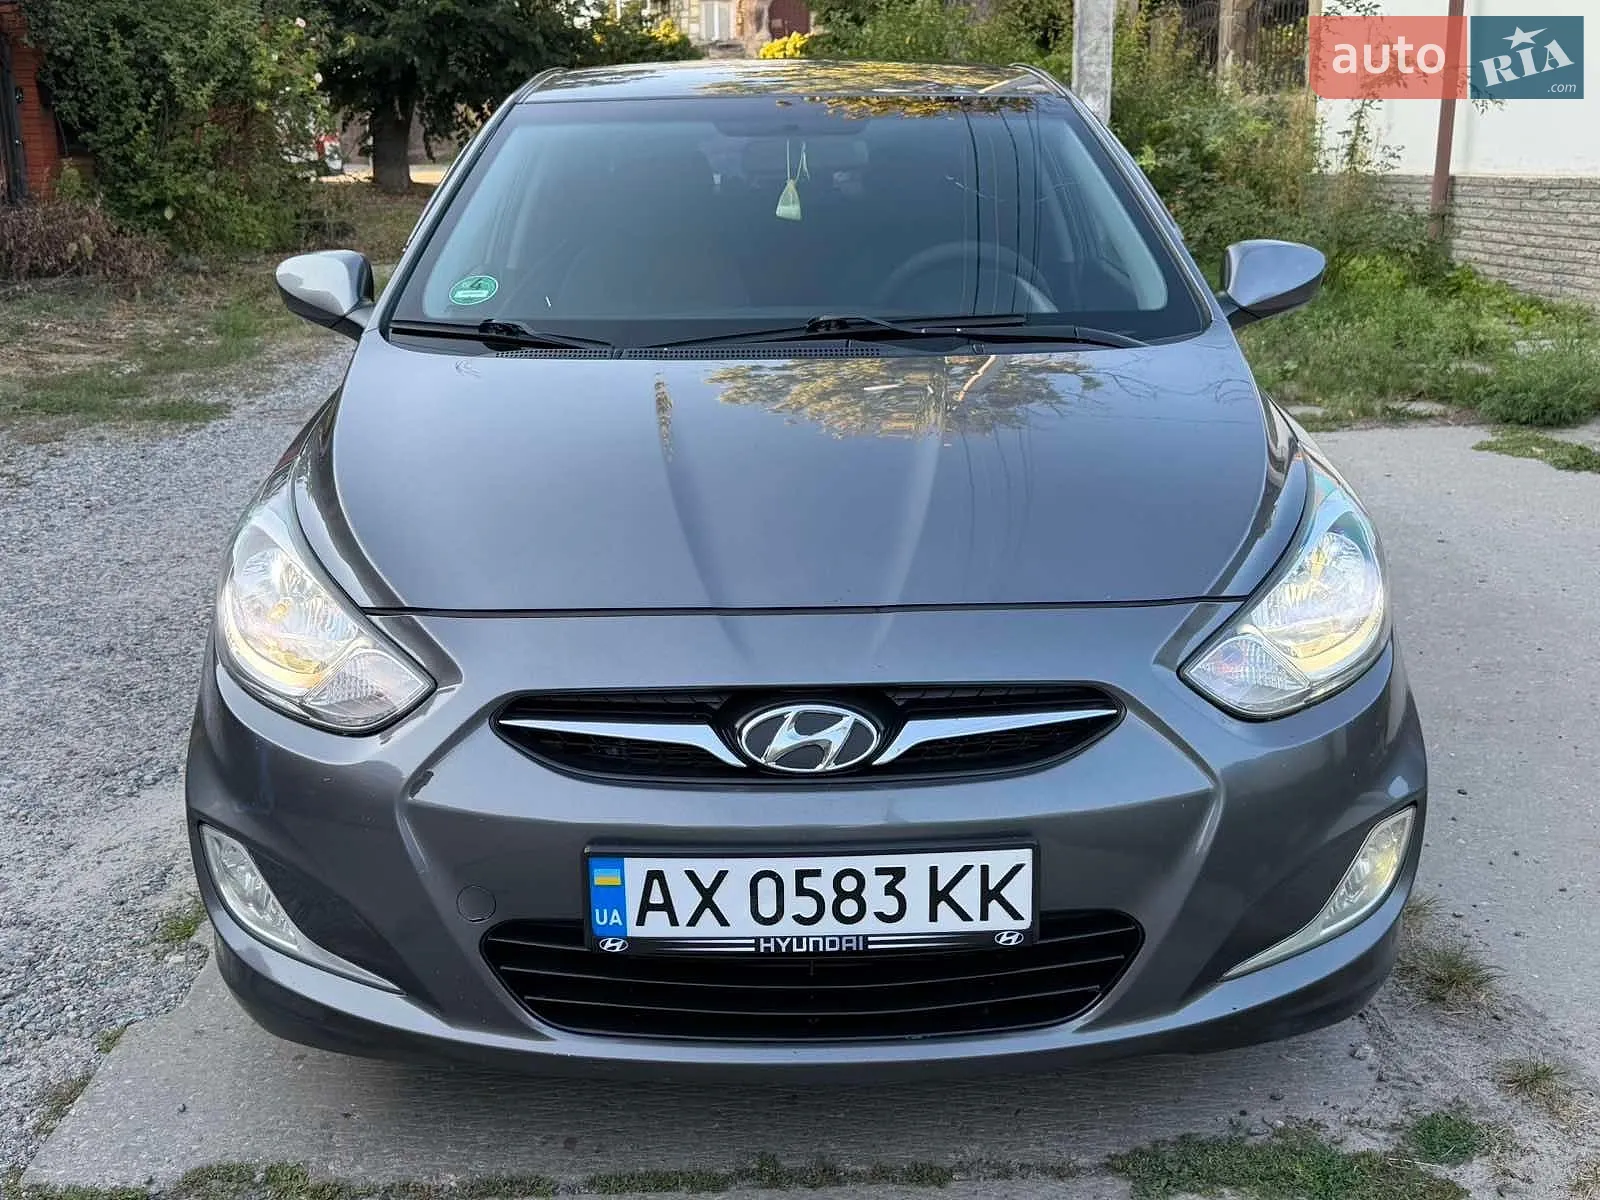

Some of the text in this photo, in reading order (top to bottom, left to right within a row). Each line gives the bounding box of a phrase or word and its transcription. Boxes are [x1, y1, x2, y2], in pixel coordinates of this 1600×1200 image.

[635, 864, 1026, 927] AX 0583 KK
[595, 909, 623, 926] UA
[759, 936, 865, 954] HYUNDAI
